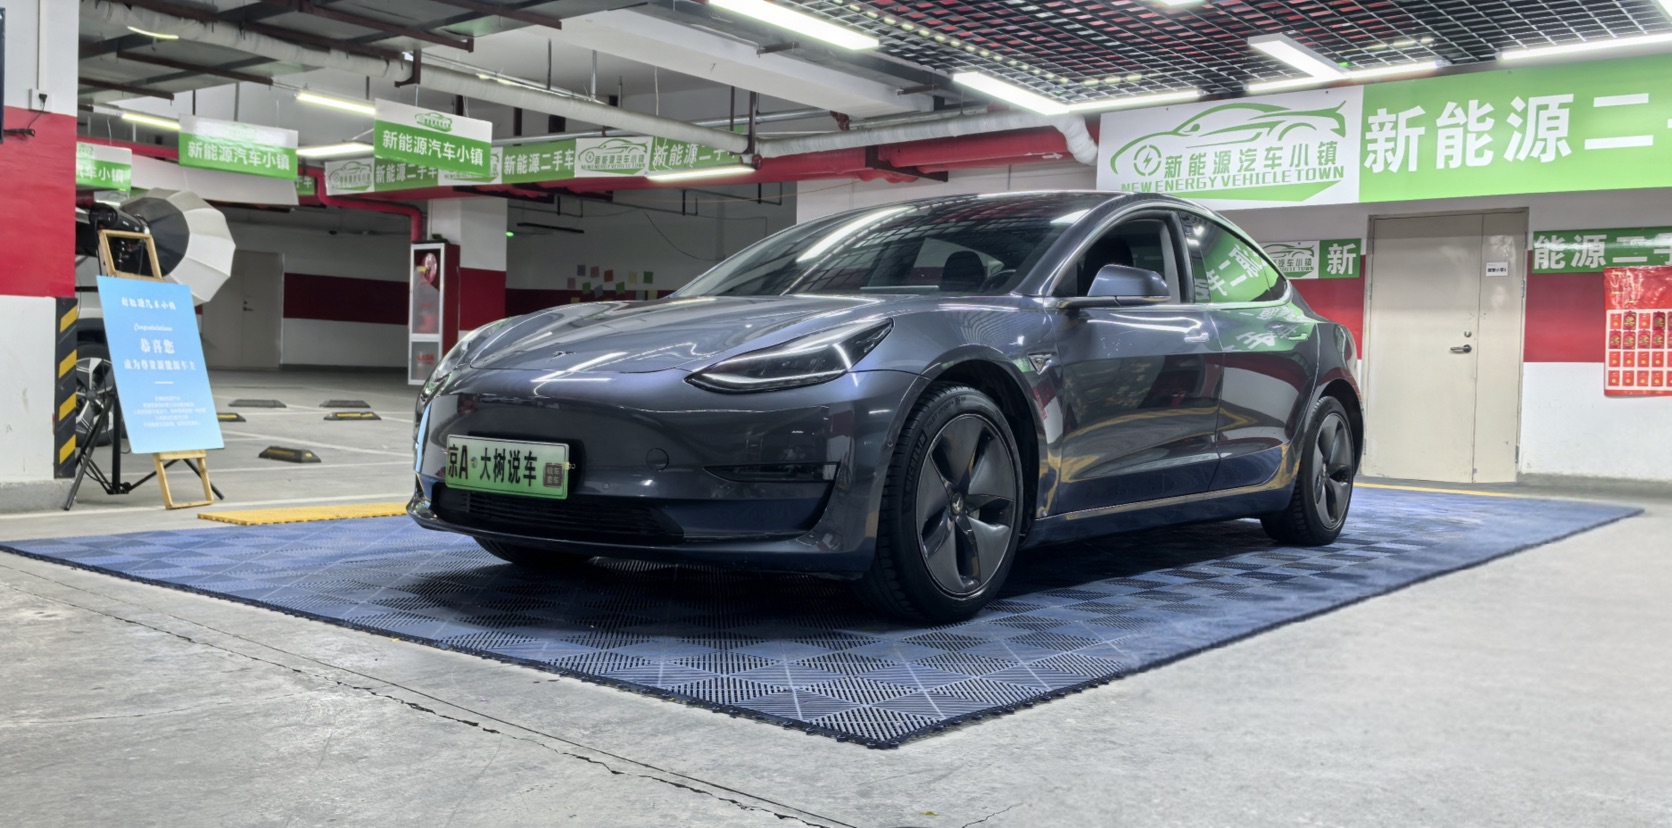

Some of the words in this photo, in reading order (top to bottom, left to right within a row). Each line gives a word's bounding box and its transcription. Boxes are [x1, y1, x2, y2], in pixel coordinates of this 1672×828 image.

[382, 129, 484, 167] 新能源汽车小镇
[1364, 93, 1672, 173] 新能源二
[187, 141, 290, 171] 新能源汽车小镇
[503, 149, 575, 175] 新能源二手车
[1164, 141, 1338, 179] 新能源汽车小镇
[1121, 181, 1152, 193] NEW
[1155, 176, 1218, 193] ENERGY
[1221, 168, 1295, 188] VEHICLE
[1295, 165, 1345, 182] TOWN
[1327, 243, 1357, 275] 新
[904, 433, 927, 494] MICHELIN
